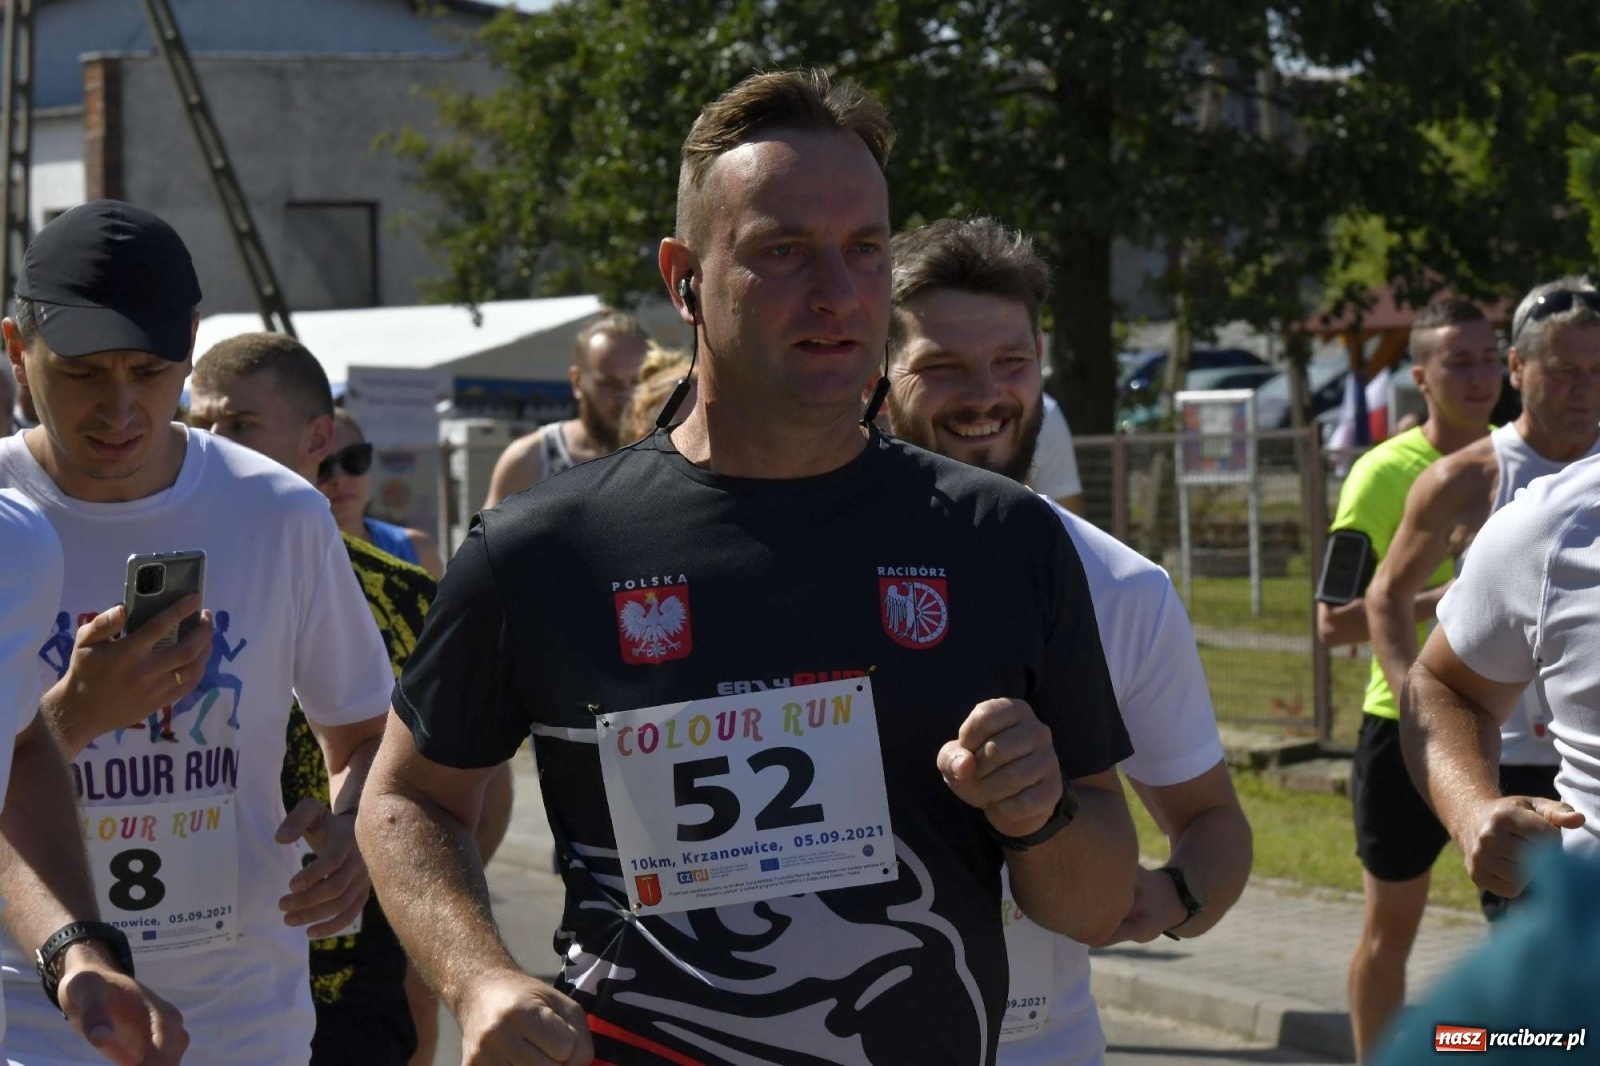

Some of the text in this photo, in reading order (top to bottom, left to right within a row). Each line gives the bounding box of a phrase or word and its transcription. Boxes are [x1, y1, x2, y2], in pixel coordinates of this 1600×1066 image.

[612, 574, 688, 591] POLSKA
[877, 565, 947, 577] RACIBÓRZ
[617, 694, 853, 757] COLOUR RUN
[185, 746, 240, 792] RUN
[673, 746, 824, 842] 52
[172, 807, 221, 839] RUN
[631, 855, 677, 872] 10km,
[682, 840, 784, 866] Krzanowice,
[793, 825, 885, 849] 05.09.2021
[109, 848, 165, 911] 8
[169, 906, 232, 924] 05.09.2021
